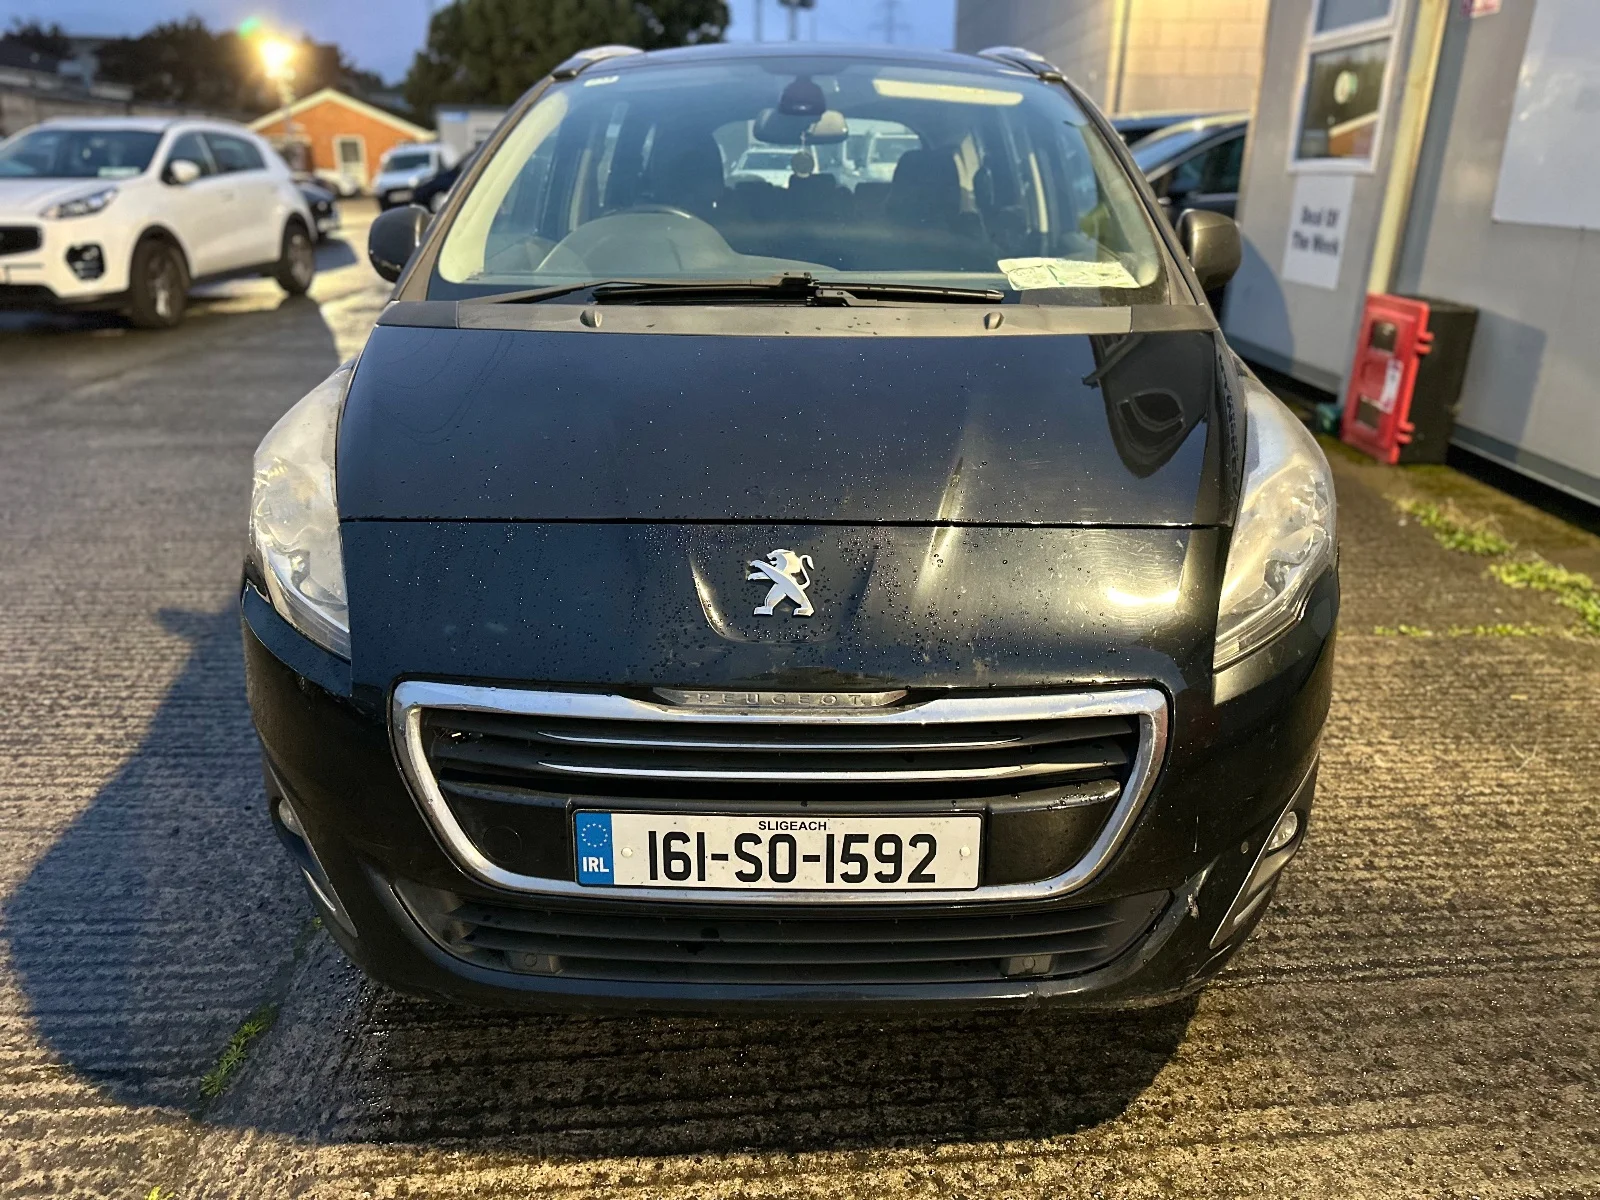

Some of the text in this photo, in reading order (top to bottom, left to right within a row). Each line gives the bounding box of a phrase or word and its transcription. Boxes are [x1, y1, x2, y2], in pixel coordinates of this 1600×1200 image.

[697, 692, 862, 706] PEUGEOT
[758, 820, 828, 831] SLIGEACH
[582, 856, 610, 873] IRL
[648, 830, 938, 884] 161-SO-1592
